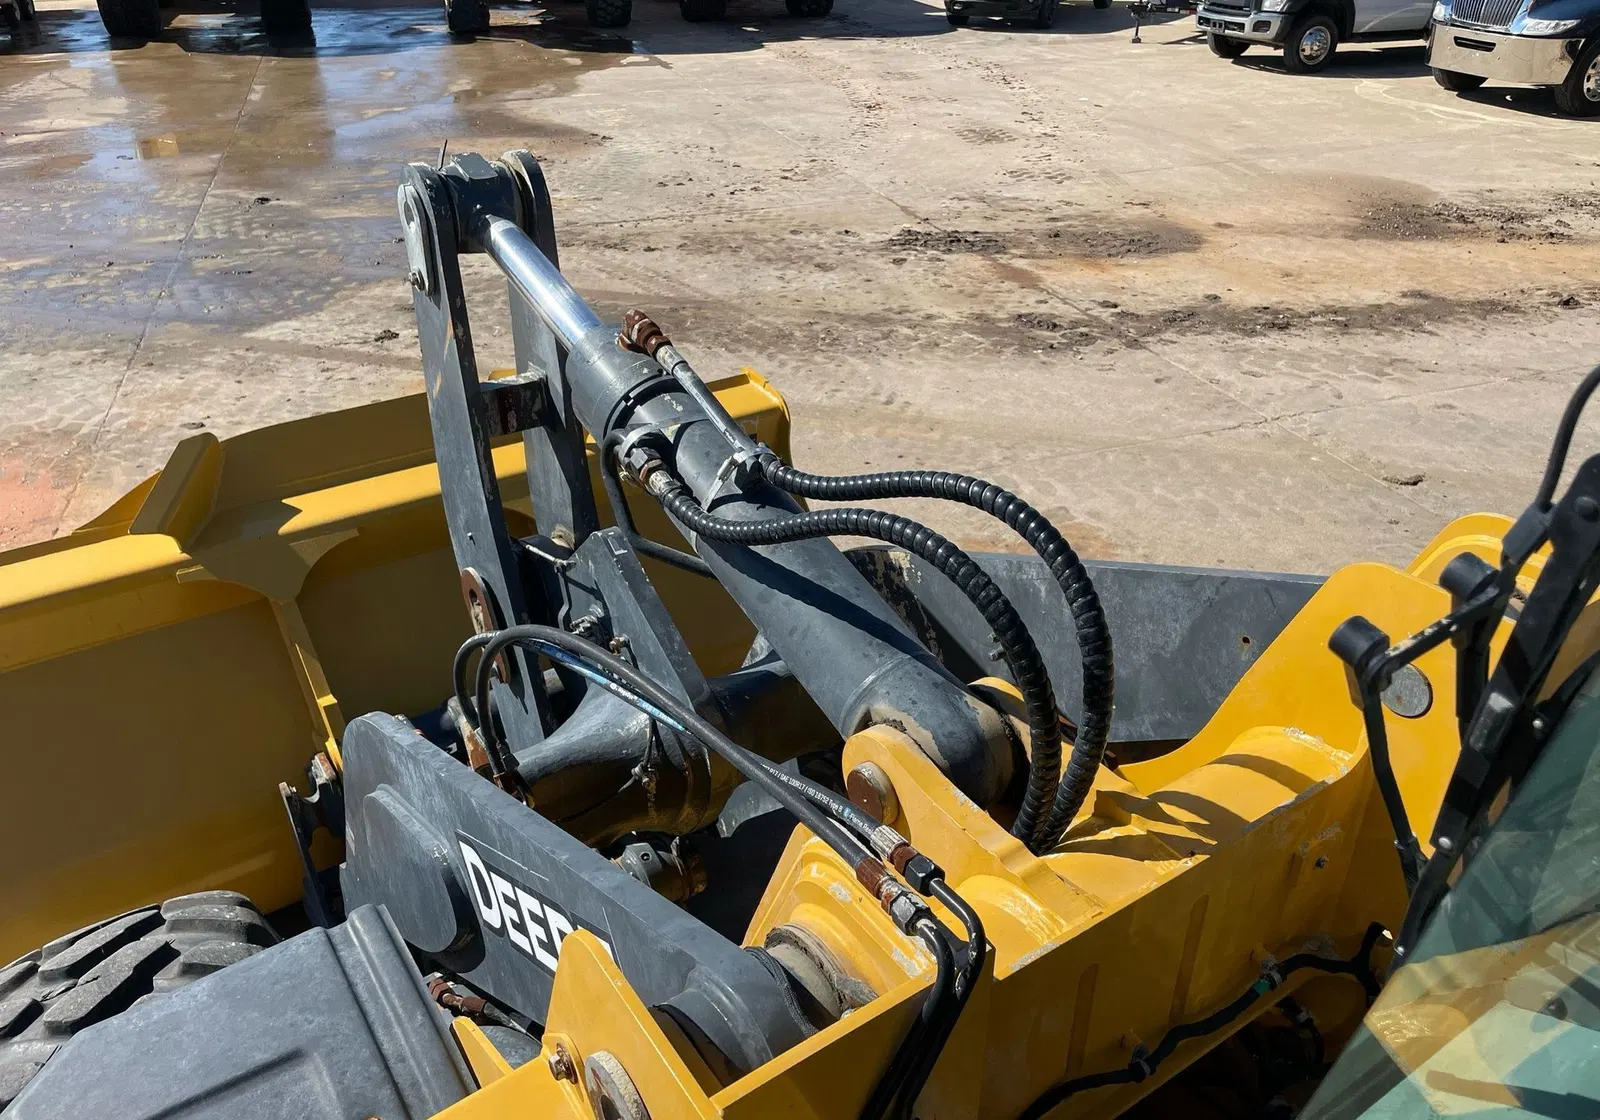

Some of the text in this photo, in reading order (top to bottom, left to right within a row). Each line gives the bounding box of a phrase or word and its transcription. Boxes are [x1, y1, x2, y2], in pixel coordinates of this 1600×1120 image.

[780, 774, 790, 783] SAE
[807, 787, 816, 797] ISO
[829, 798, 839, 811] Type
[849, 813, 864, 828] Flame
[459, 840, 616, 971] DEE
